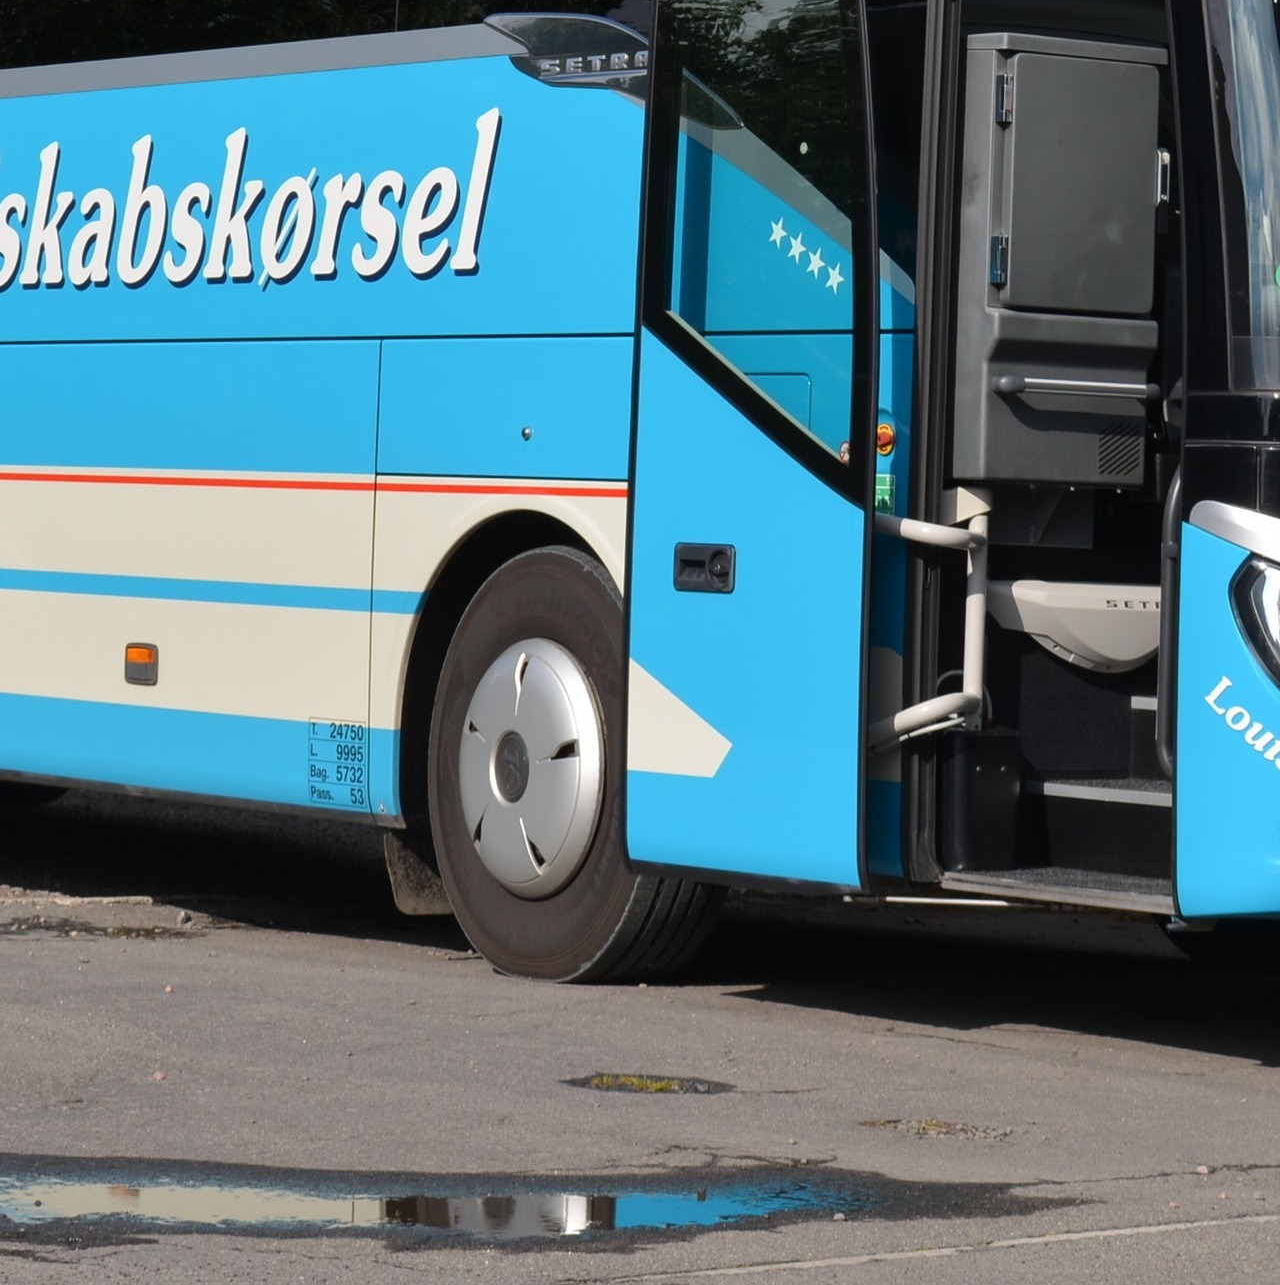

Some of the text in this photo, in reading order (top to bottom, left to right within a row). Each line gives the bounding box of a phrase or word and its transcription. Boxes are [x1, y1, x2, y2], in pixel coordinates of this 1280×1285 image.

[540, 51, 648, 76] SETRA
[330, 722, 364, 742] 24750
[336, 744, 363, 763] 9995
[310, 764, 363, 784] Bag. 5732
[310, 786, 364, 805] Pass. 53
